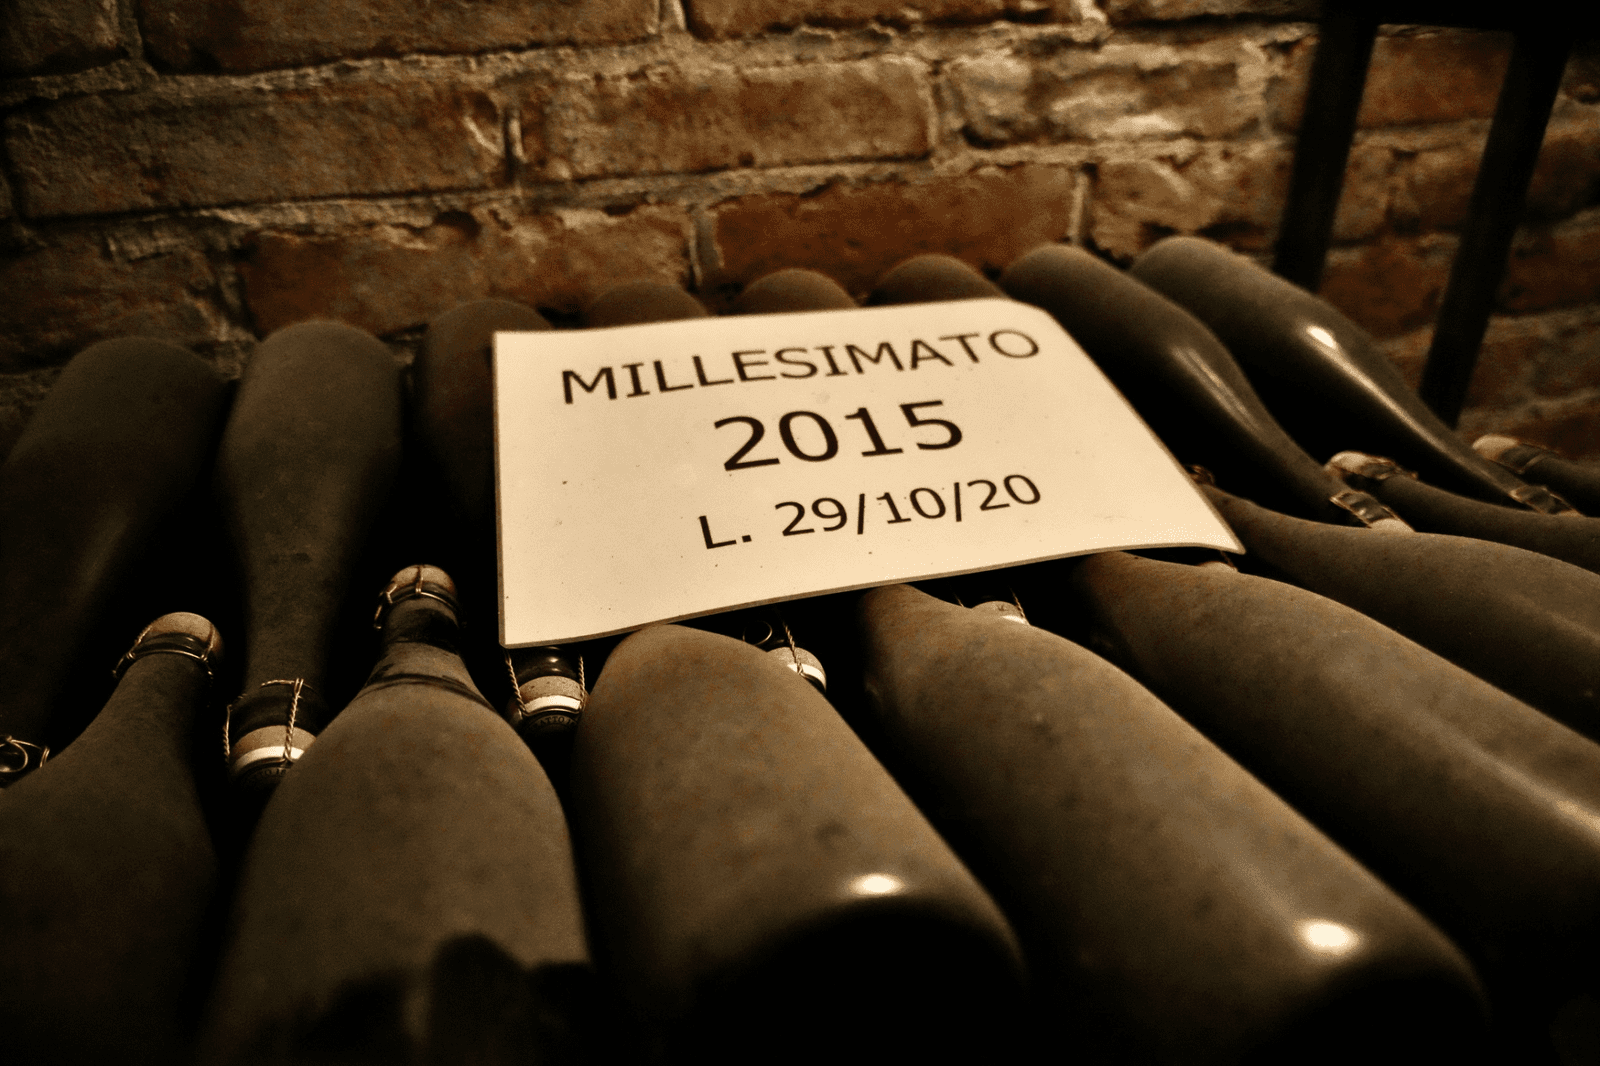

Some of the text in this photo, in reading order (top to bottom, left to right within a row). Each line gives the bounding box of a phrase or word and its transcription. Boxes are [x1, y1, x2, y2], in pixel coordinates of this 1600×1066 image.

[562, 330, 1039, 405] MILLESIMATO
[713, 400, 963, 472] 2015
[698, 474, 1041, 550] L. 29/10/20
